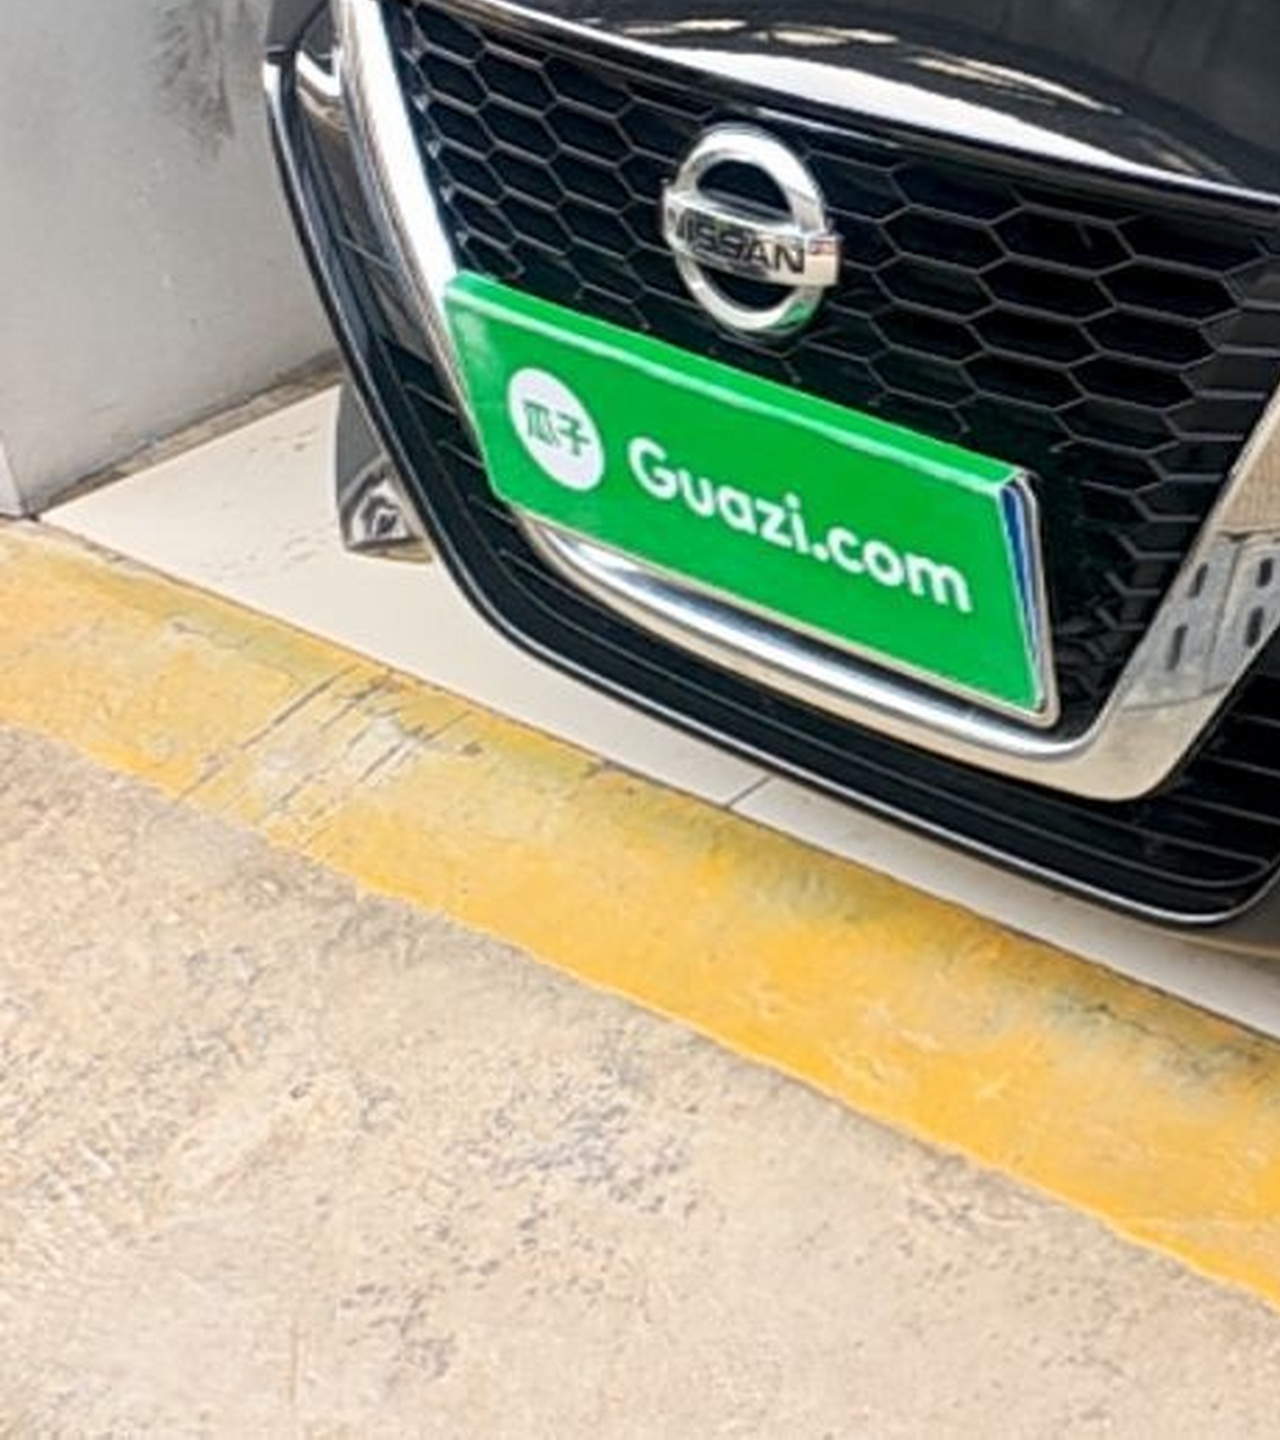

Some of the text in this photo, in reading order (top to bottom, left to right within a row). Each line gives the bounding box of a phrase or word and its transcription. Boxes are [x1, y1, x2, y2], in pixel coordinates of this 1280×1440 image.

[667, 207, 805, 275] NISSAN
[523, 400, 590, 456] 瓜子
[628, 437, 973, 613] Guazi.com
